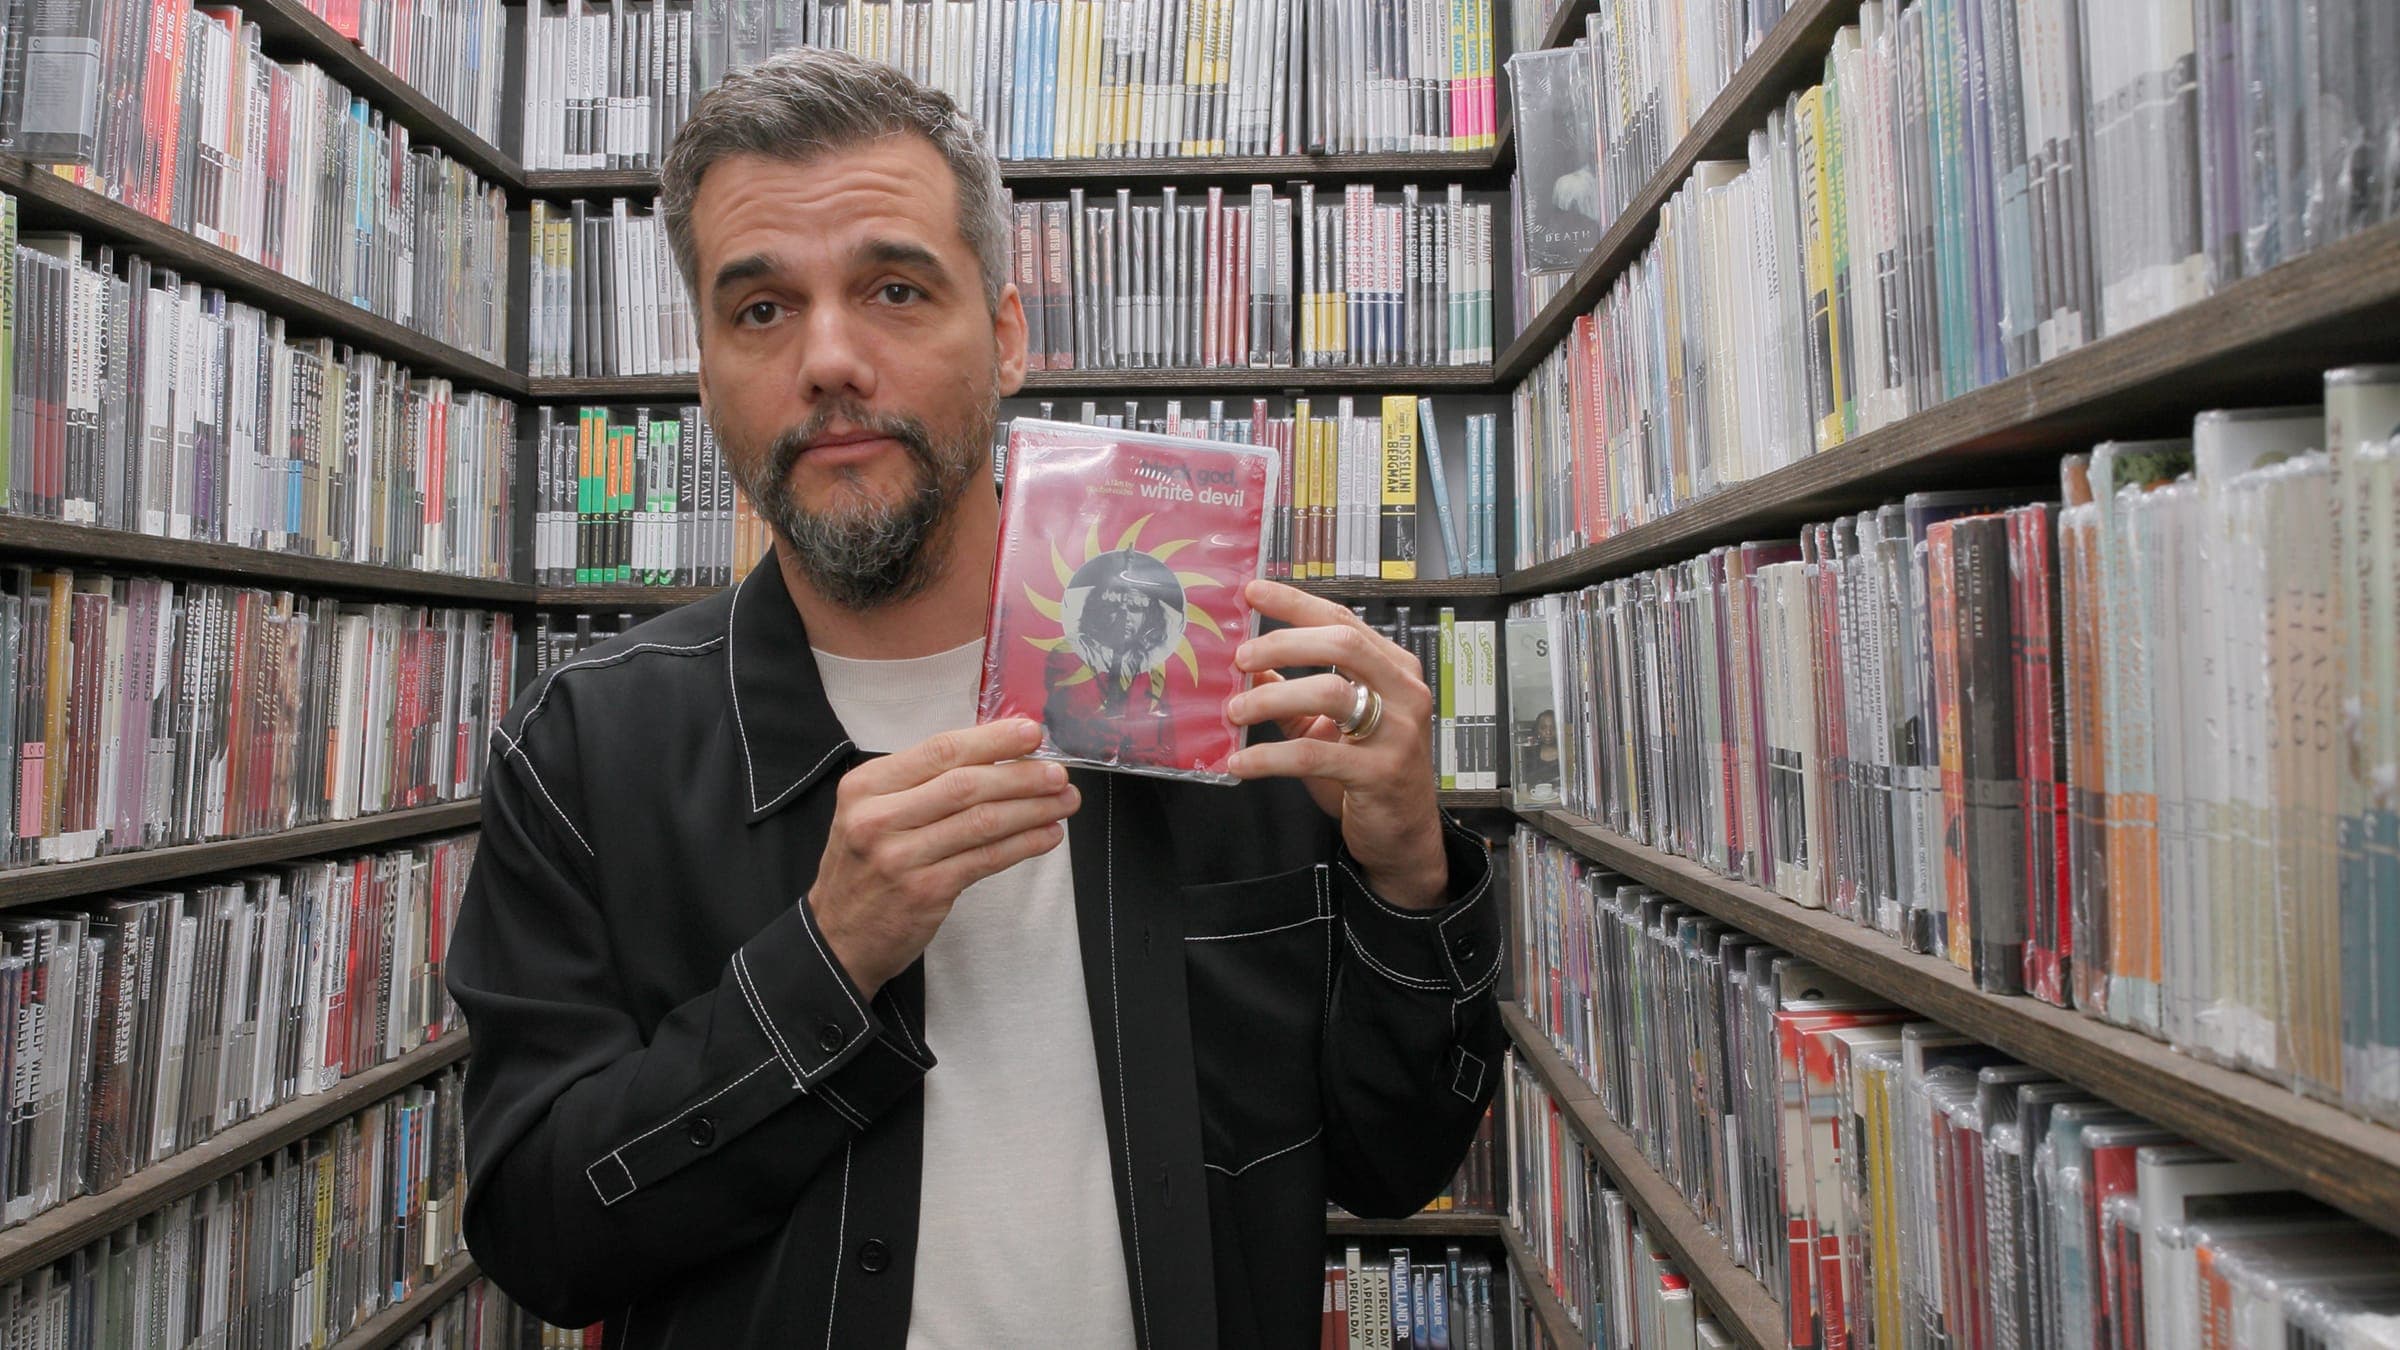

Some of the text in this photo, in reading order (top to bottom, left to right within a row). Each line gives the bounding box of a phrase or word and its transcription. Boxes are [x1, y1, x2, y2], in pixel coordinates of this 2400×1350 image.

[154, 4, 165, 54] SOLDIER
[165, 12, 175, 61] SOLDIER
[666, 19, 677, 95] THE WAR ROOM
[1468, 40, 1478, 73] RAOUL
[1021, 213, 1031, 227] THE
[1049, 213, 1059, 227] THE
[1255, 207, 1267, 220] THE
[1346, 192, 1359, 242] MINISTRY
[1361, 192, 1374, 242] MINISTRY
[1391, 212, 1402, 253] MINISTRY
[1435, 224, 1446, 243] MAN
[1449, 200, 1461, 250] BADLANDS
[1255, 222, 1268, 269] WATERFRONT
[1275, 209, 1288, 286] ON THE WATERFRONT
[1464, 216, 1476, 267] BADLANDS
[1479, 214, 1491, 265] BADLANDS
[1545, 230, 1591, 243] DEATH
[1022, 254, 1033, 284] TRILOGY
[1050, 254, 1061, 284] TRILOGY
[1346, 261, 1359, 288] FEAR
[1361, 261, 1374, 288] FEAR
[1376, 267, 1387, 289] FEAR
[1391, 268, 1402, 289] FEAR
[1406, 239, 1417, 278] ESCAPED
[1420, 245, 1432, 283] ESCAPED
[1435, 246, 1446, 283] ESCAPED
[100, 263, 110, 348] UMBERTO
[110, 304, 119, 383] UMBERTO
[119, 300, 128, 379] UMBERTO
[637, 416, 648, 438] REPO
[682, 417, 694, 503] PIERRE ETAIX
[701, 424, 713, 509] PIERRE ETAIX
[1196, 468, 1238, 490] god,
[1388, 441, 1399, 493] BERGMAN
[1400, 435, 1411, 493] ROSSELLINI
[1432, 457, 1443, 481] Witch
[720, 471, 732, 509] ETAIX
[1139, 482, 1245, 508] white devil
[1971, 544, 1983, 638] CITIZEN KANE
[210, 598, 222, 701] FIGHTING ELEGY
[221, 610, 229, 647] CASQUE
[230, 610, 238, 647] CASQUE
[182, 598, 195, 703] YOUTH BEAST
[189, 600, 202, 701] YOUTH BEAST
[201, 599, 213, 702] FIGHTING ELEGY
[256, 604, 270, 705] NIGHT CITY
[537, 626, 546, 675] THE UNINVIT
[551, 647, 560, 662] THE
[262, 627, 275, 728] NIGHT CITY
[271, 627, 283, 727] NIGHT CITY
[22, 938, 35, 965] THE
[39, 935, 52, 962] THE
[117, 954, 128, 1025] CONFIDENTIAL
[119, 920, 139, 1064] MR. ARKADIN
[18, 1009, 30, 1056] SLEEP
[33, 1006, 46, 1051] SLEEP
[15, 1064, 27, 1107] WELL
[29, 1059, 43, 1101] WELL
[1349, 1276, 1359, 1319] SPECIAL
[1363, 1284, 1373, 1327] SPECIAL
[1378, 1285, 1388, 1327] SPECIAL
[1394, 1256, 1409, 1342] MULHOLLAND DR.
[1414, 1273, 1424, 1315] MULHOLLAND
[1431, 1273, 1443, 1316] MULHOLLAND
[1350, 1319, 1360, 1339] DAY
[1365, 1328, 1375, 1349] DAY
[1379, 1328, 1389, 1350] DAY
